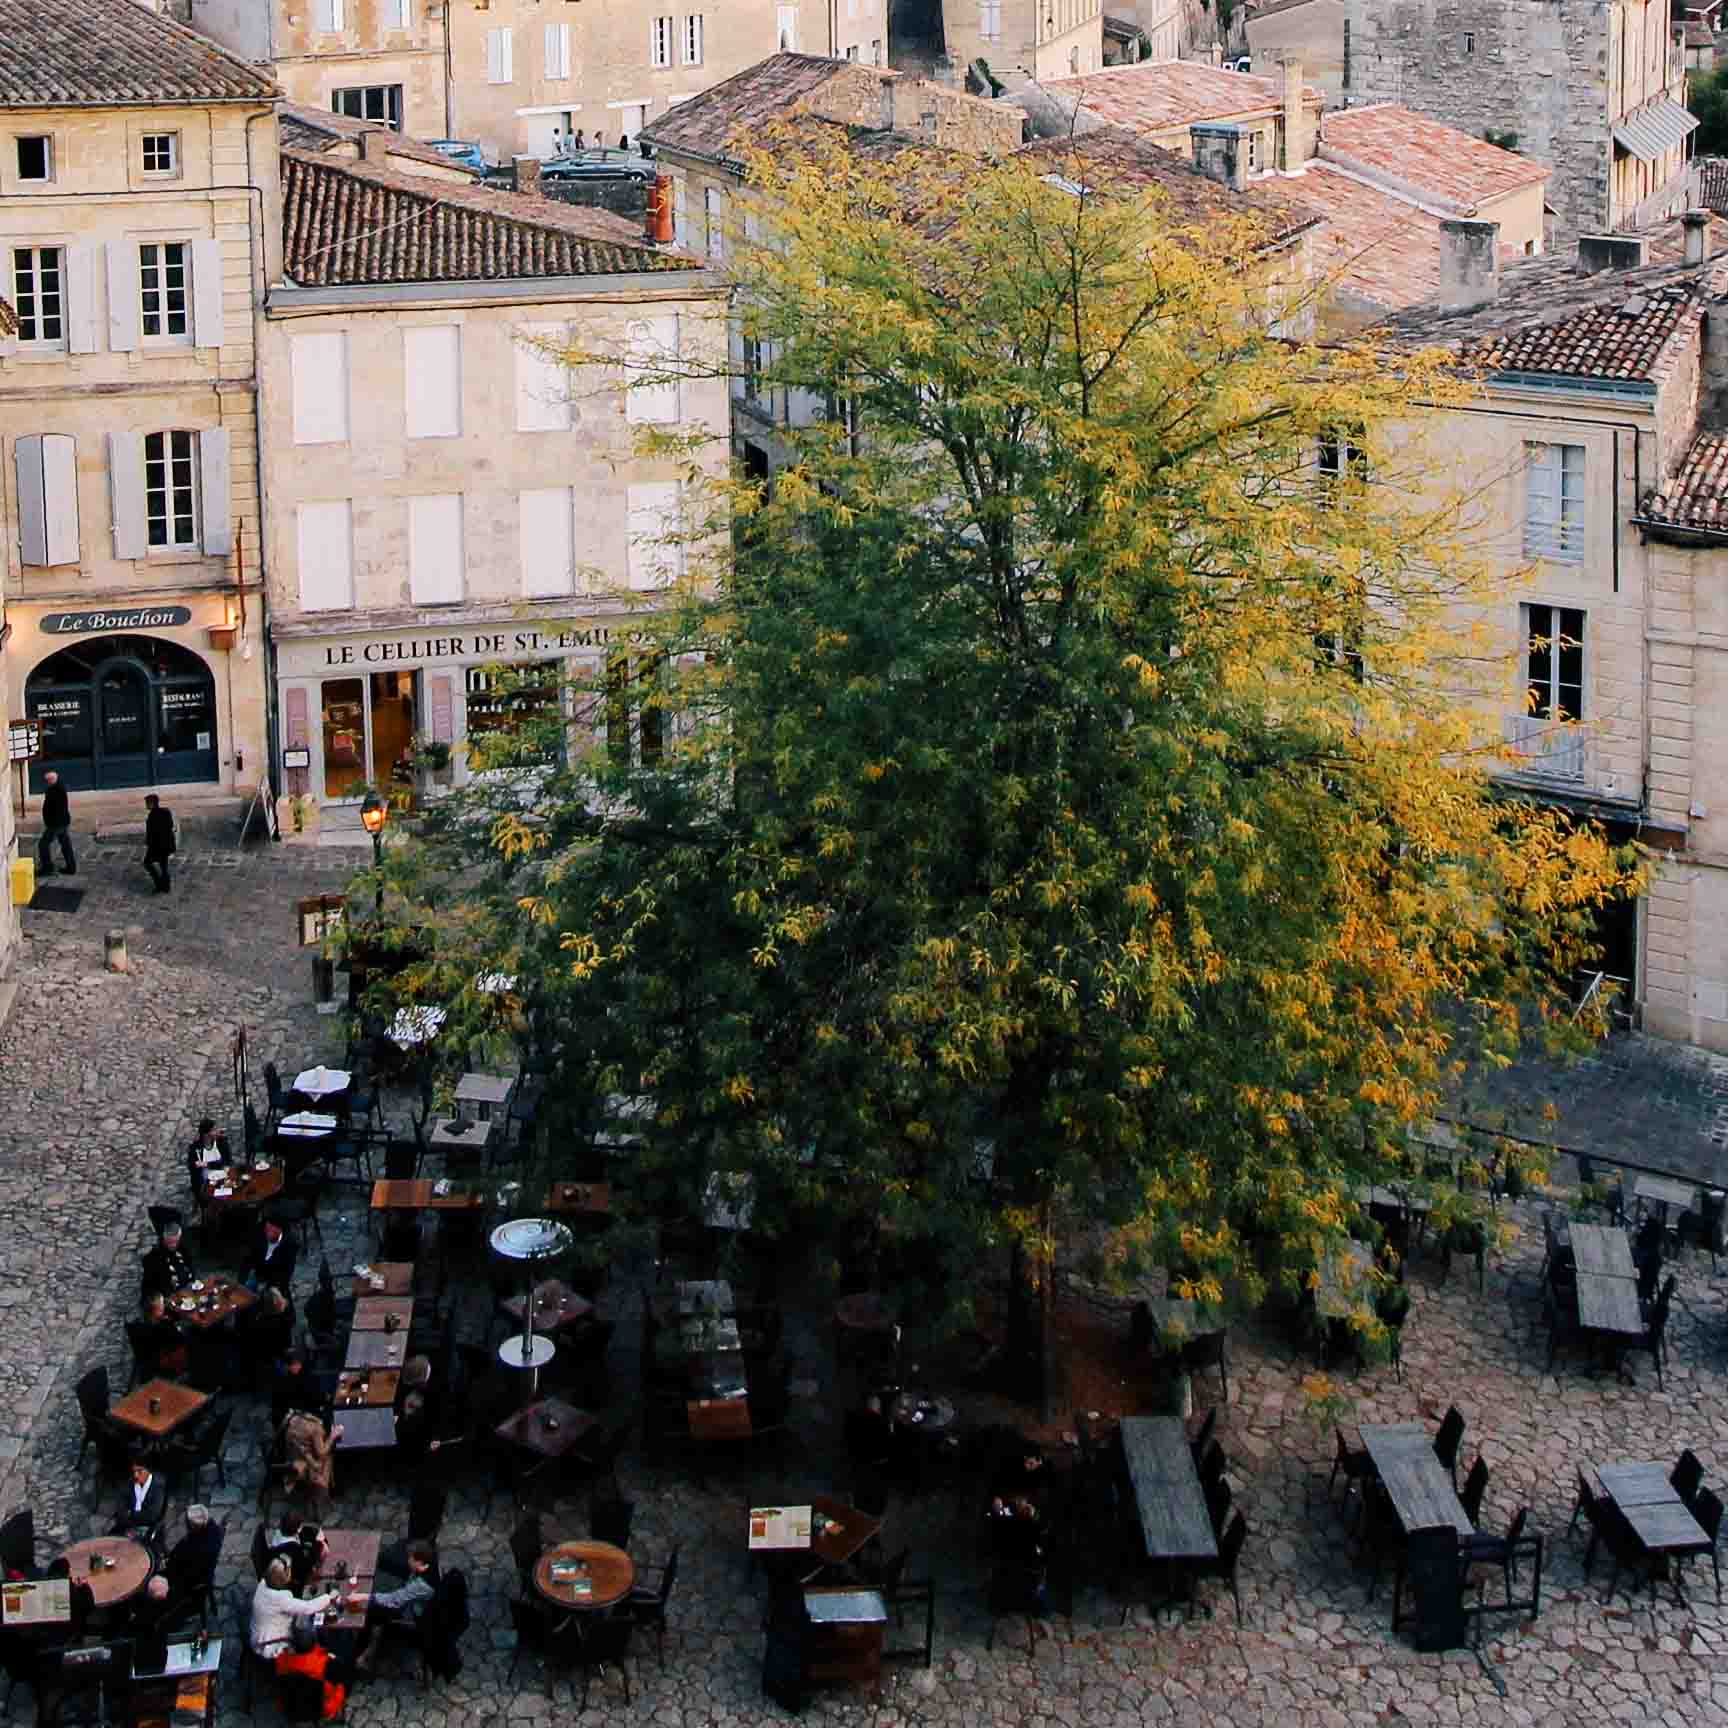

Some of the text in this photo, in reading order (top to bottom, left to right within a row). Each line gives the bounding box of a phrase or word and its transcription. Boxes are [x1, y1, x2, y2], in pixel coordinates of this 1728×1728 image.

[57, 608, 175, 632] Le Bouchon
[325, 625, 658, 666] LE CELLIER DE ST. EMILO
